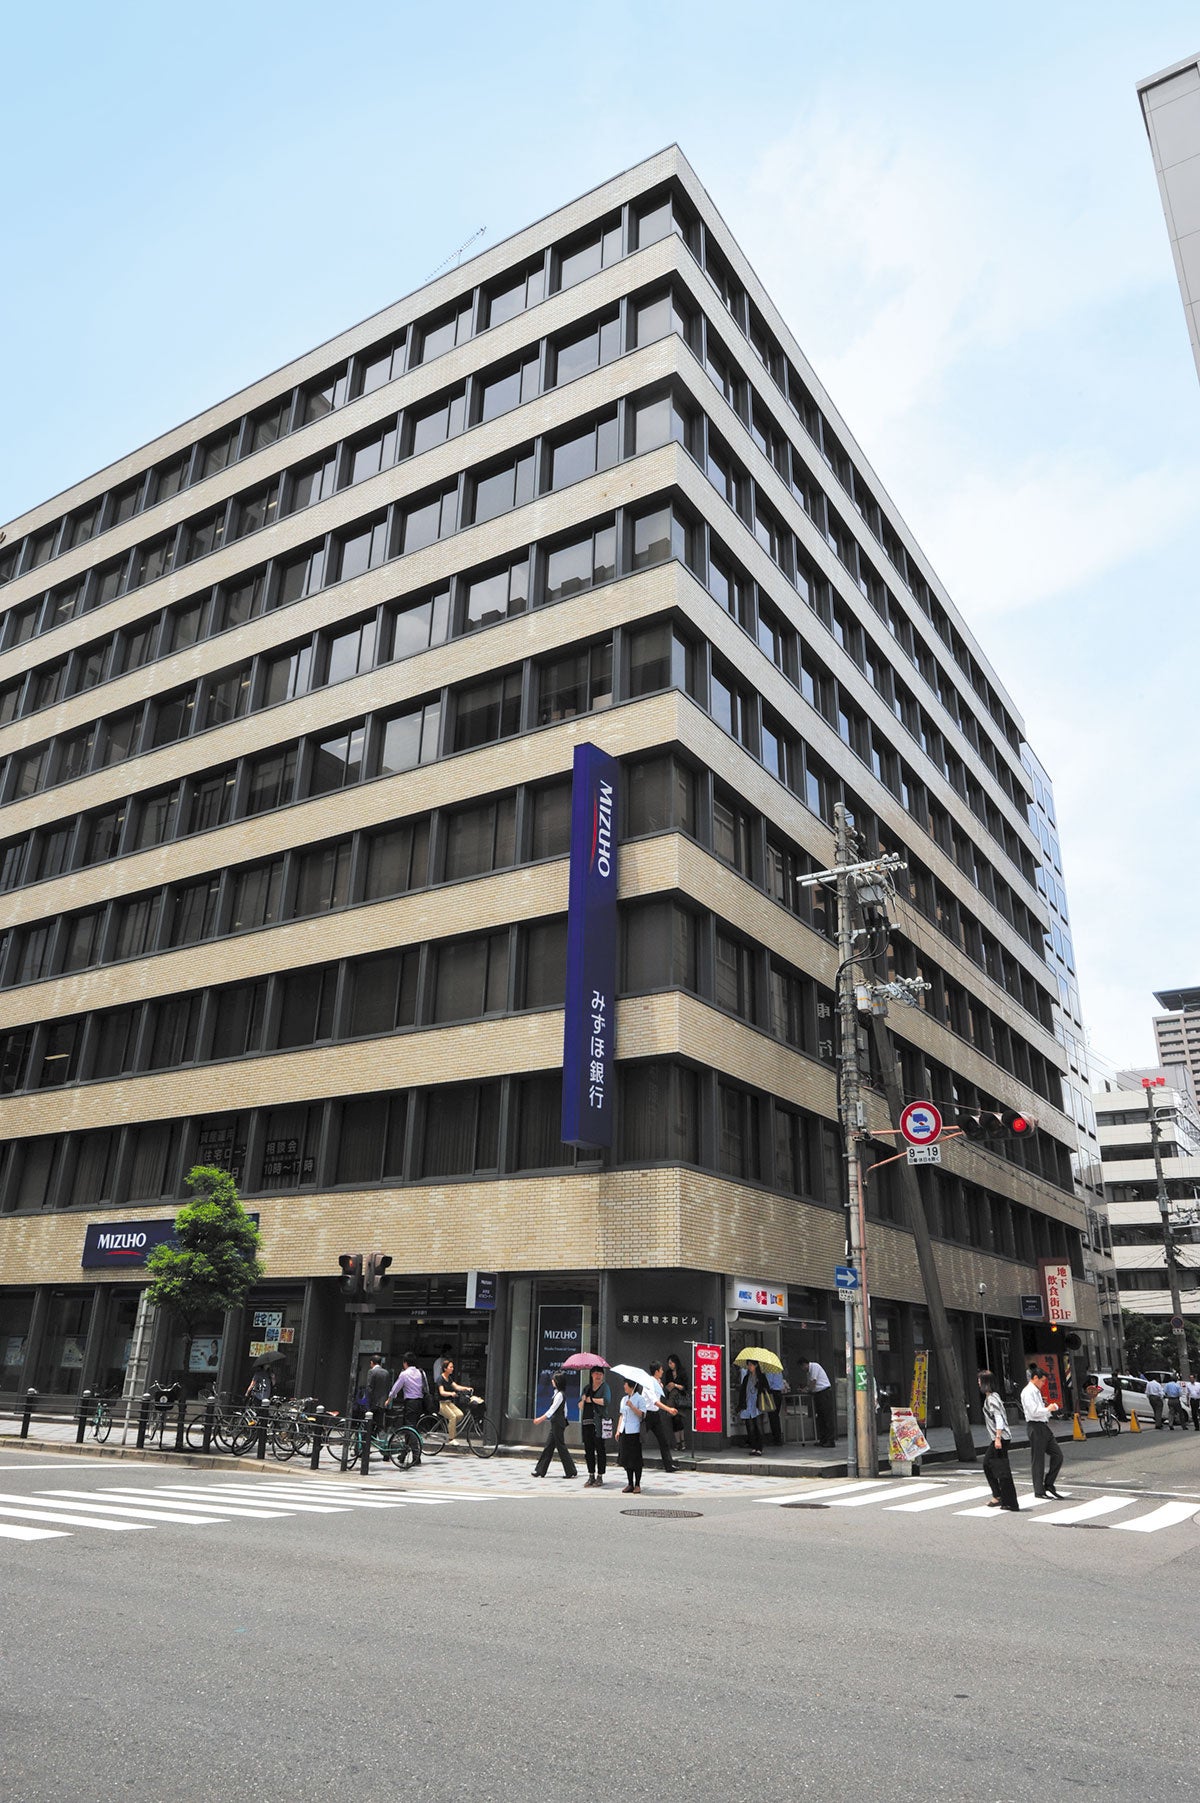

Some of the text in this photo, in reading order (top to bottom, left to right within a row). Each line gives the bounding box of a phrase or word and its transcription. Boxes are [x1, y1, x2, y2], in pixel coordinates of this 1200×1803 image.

[598, 780, 613, 877] MIZUHO
[589, 990, 606, 1109] みずほ銀行
[265, 1140, 298, 1156] 相談会
[97, 1232, 147, 1250] MIZUHO
[1056, 1266, 1068, 1289] 地下
[1047, 1275, 1060, 1308] 飲食街
[622, 1314, 698, 1325] 東京建物本町ビル
[543, 1330, 577, 1340] MIZUHO
